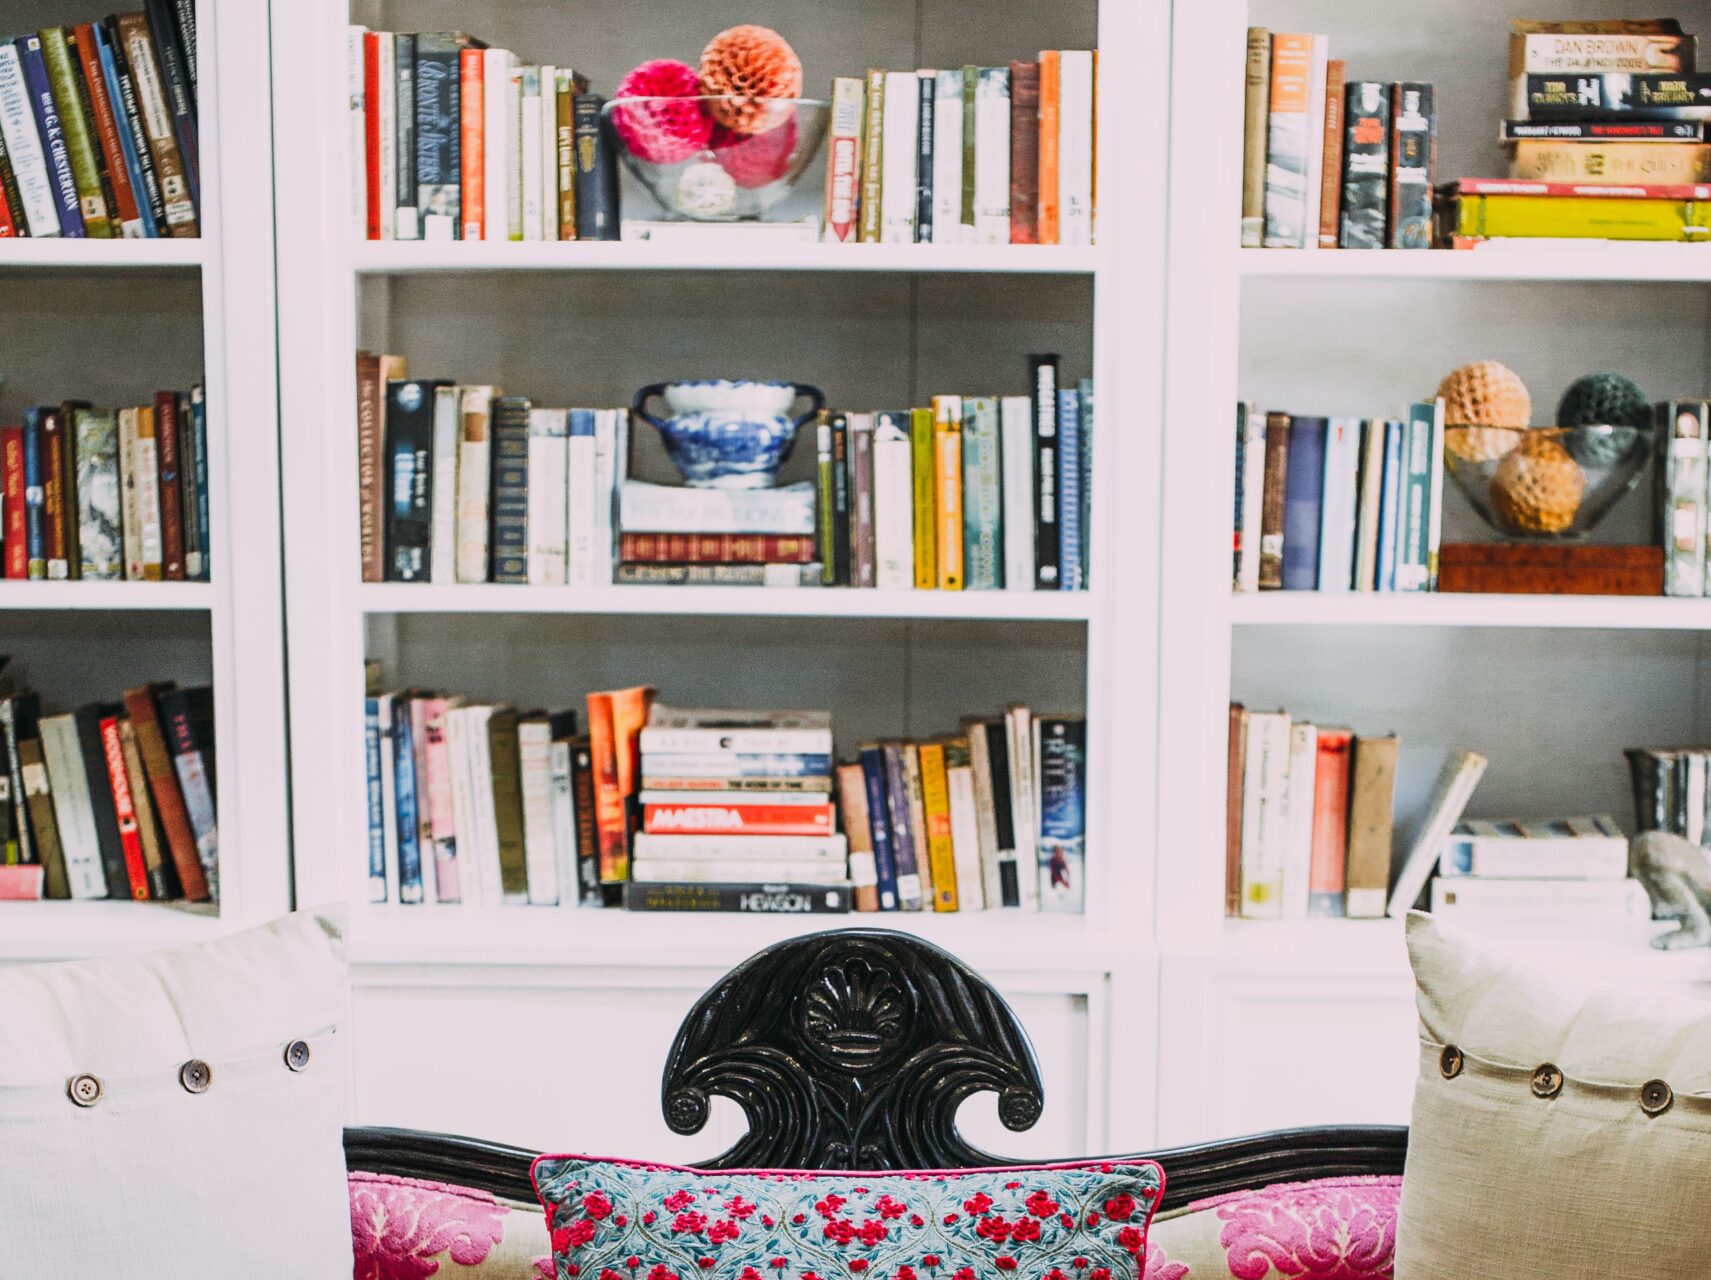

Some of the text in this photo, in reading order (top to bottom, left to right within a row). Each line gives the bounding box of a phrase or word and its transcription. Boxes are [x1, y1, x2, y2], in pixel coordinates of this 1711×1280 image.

[1555, 39, 1639, 54] DAN BROWN
[49, 138, 79, 211] CHESTERTON
[417, 124, 448, 182] SISTERS
[361, 400, 373, 487] COLLECTOR
[740, 893, 812, 911] HEWSON
